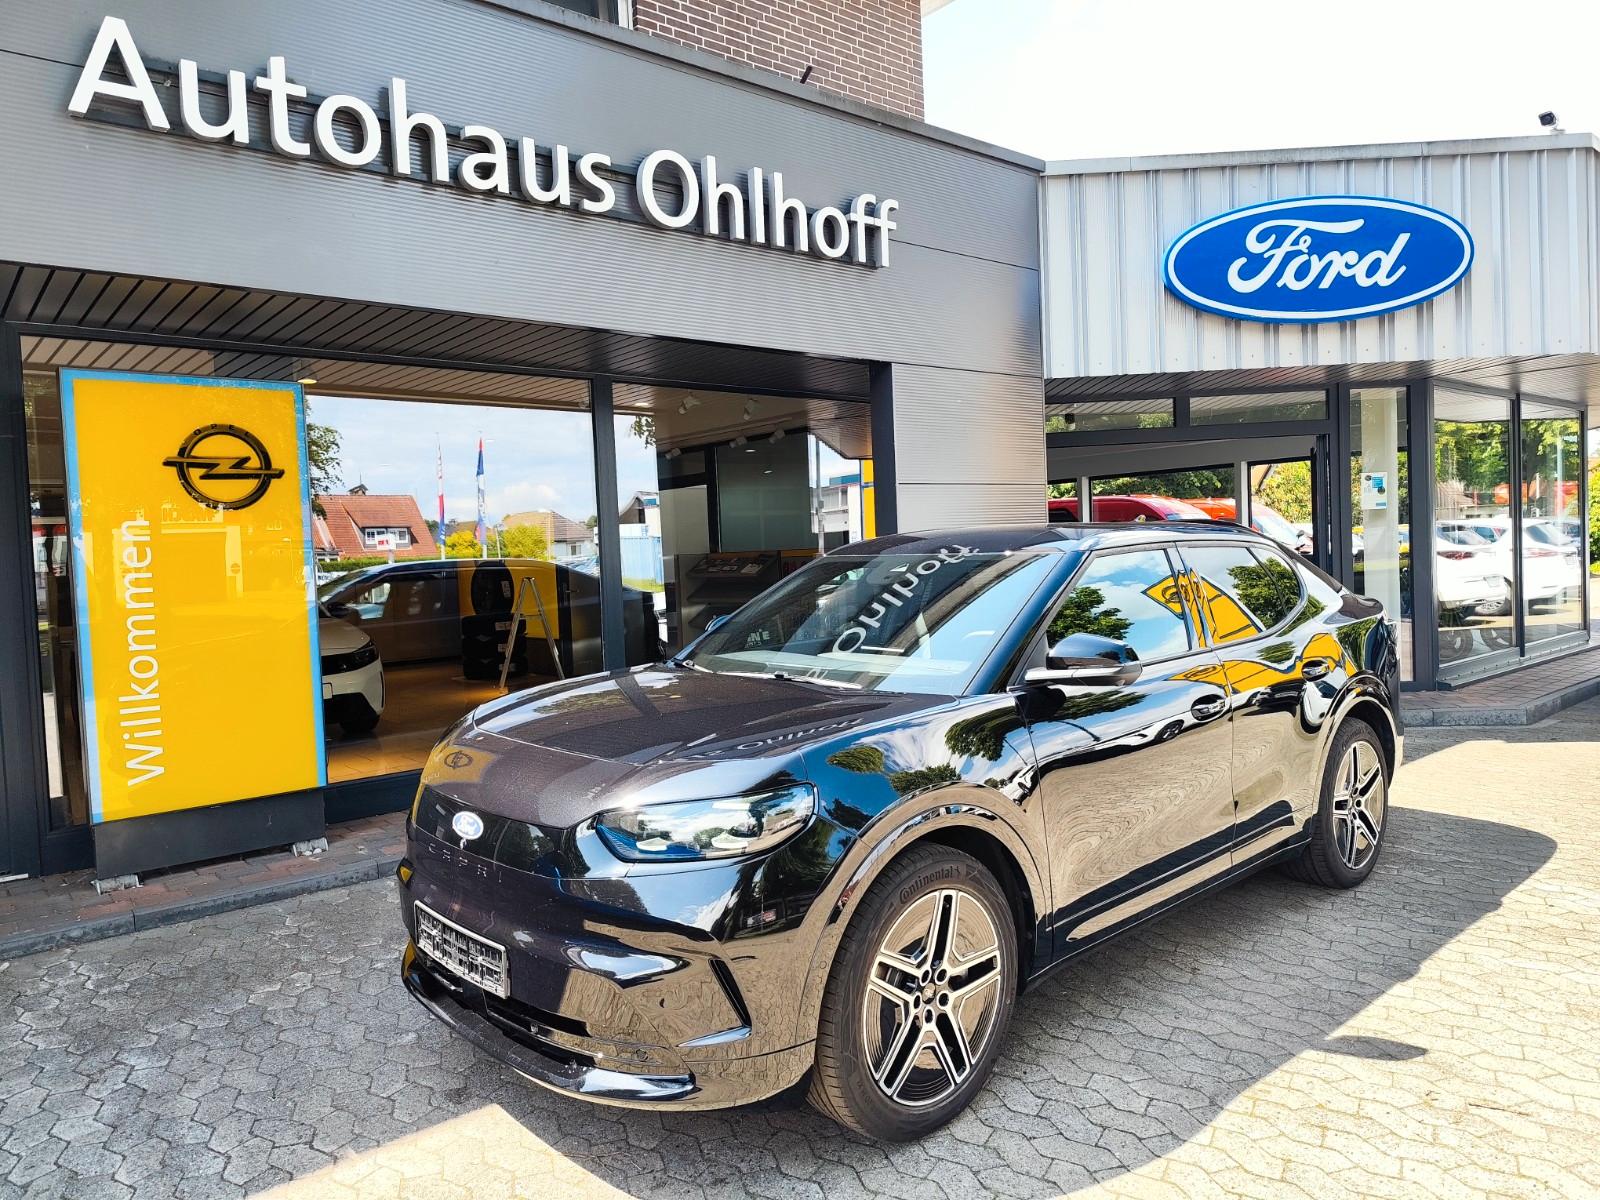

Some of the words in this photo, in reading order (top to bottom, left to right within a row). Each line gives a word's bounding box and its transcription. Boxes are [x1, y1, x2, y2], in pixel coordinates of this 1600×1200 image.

[67, 15, 617, 214] Autohaus
[636, 149, 900, 269] Ohlhoff
[1227, 217, 1411, 293] Ford
[118, 519, 166, 786] Willkommen
[428, 842, 502, 883] CAPRI
[899, 865, 953, 905] Continental
